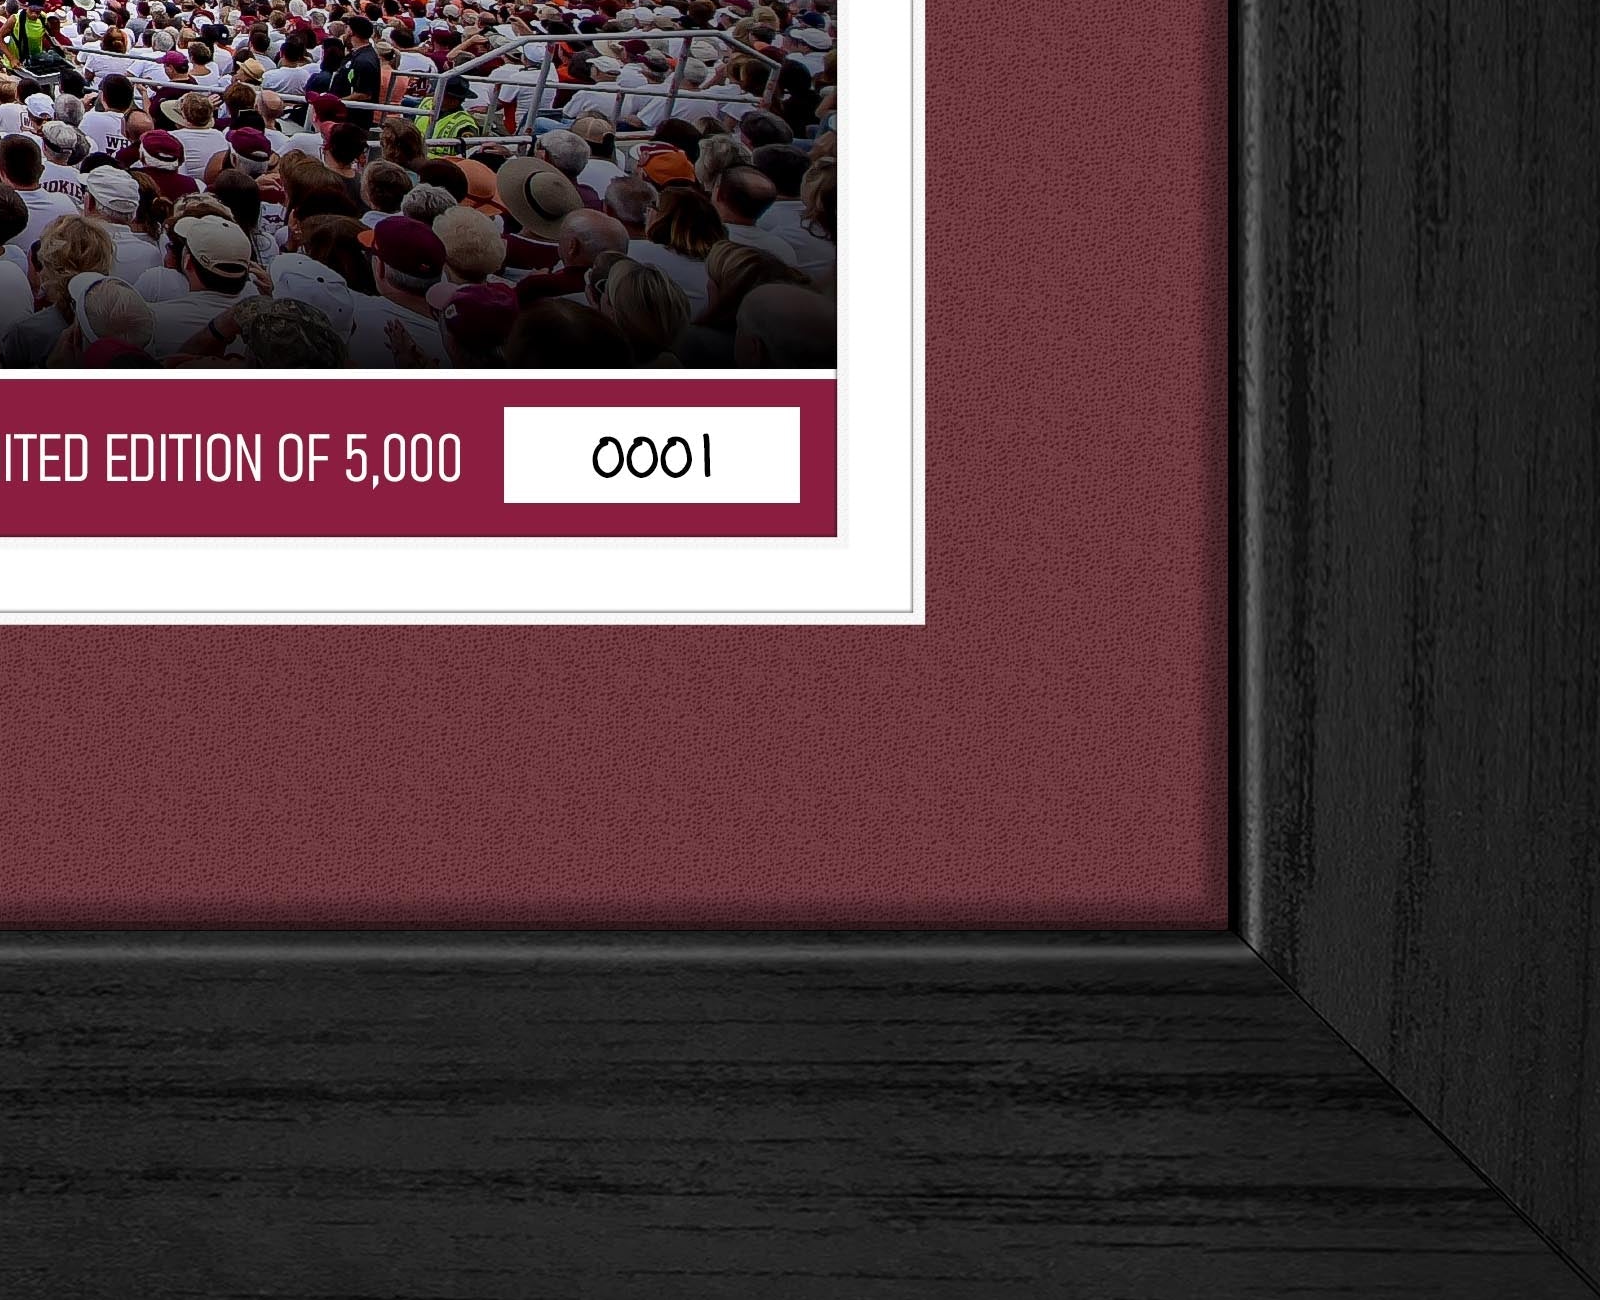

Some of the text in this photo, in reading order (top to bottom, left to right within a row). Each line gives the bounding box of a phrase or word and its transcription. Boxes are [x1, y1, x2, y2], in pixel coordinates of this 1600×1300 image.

[106, 433, 261, 483] EDITION
[278, 433, 330, 483] OF
[345, 433, 461, 490] 5,000
[592, 433, 711, 479] 0001
